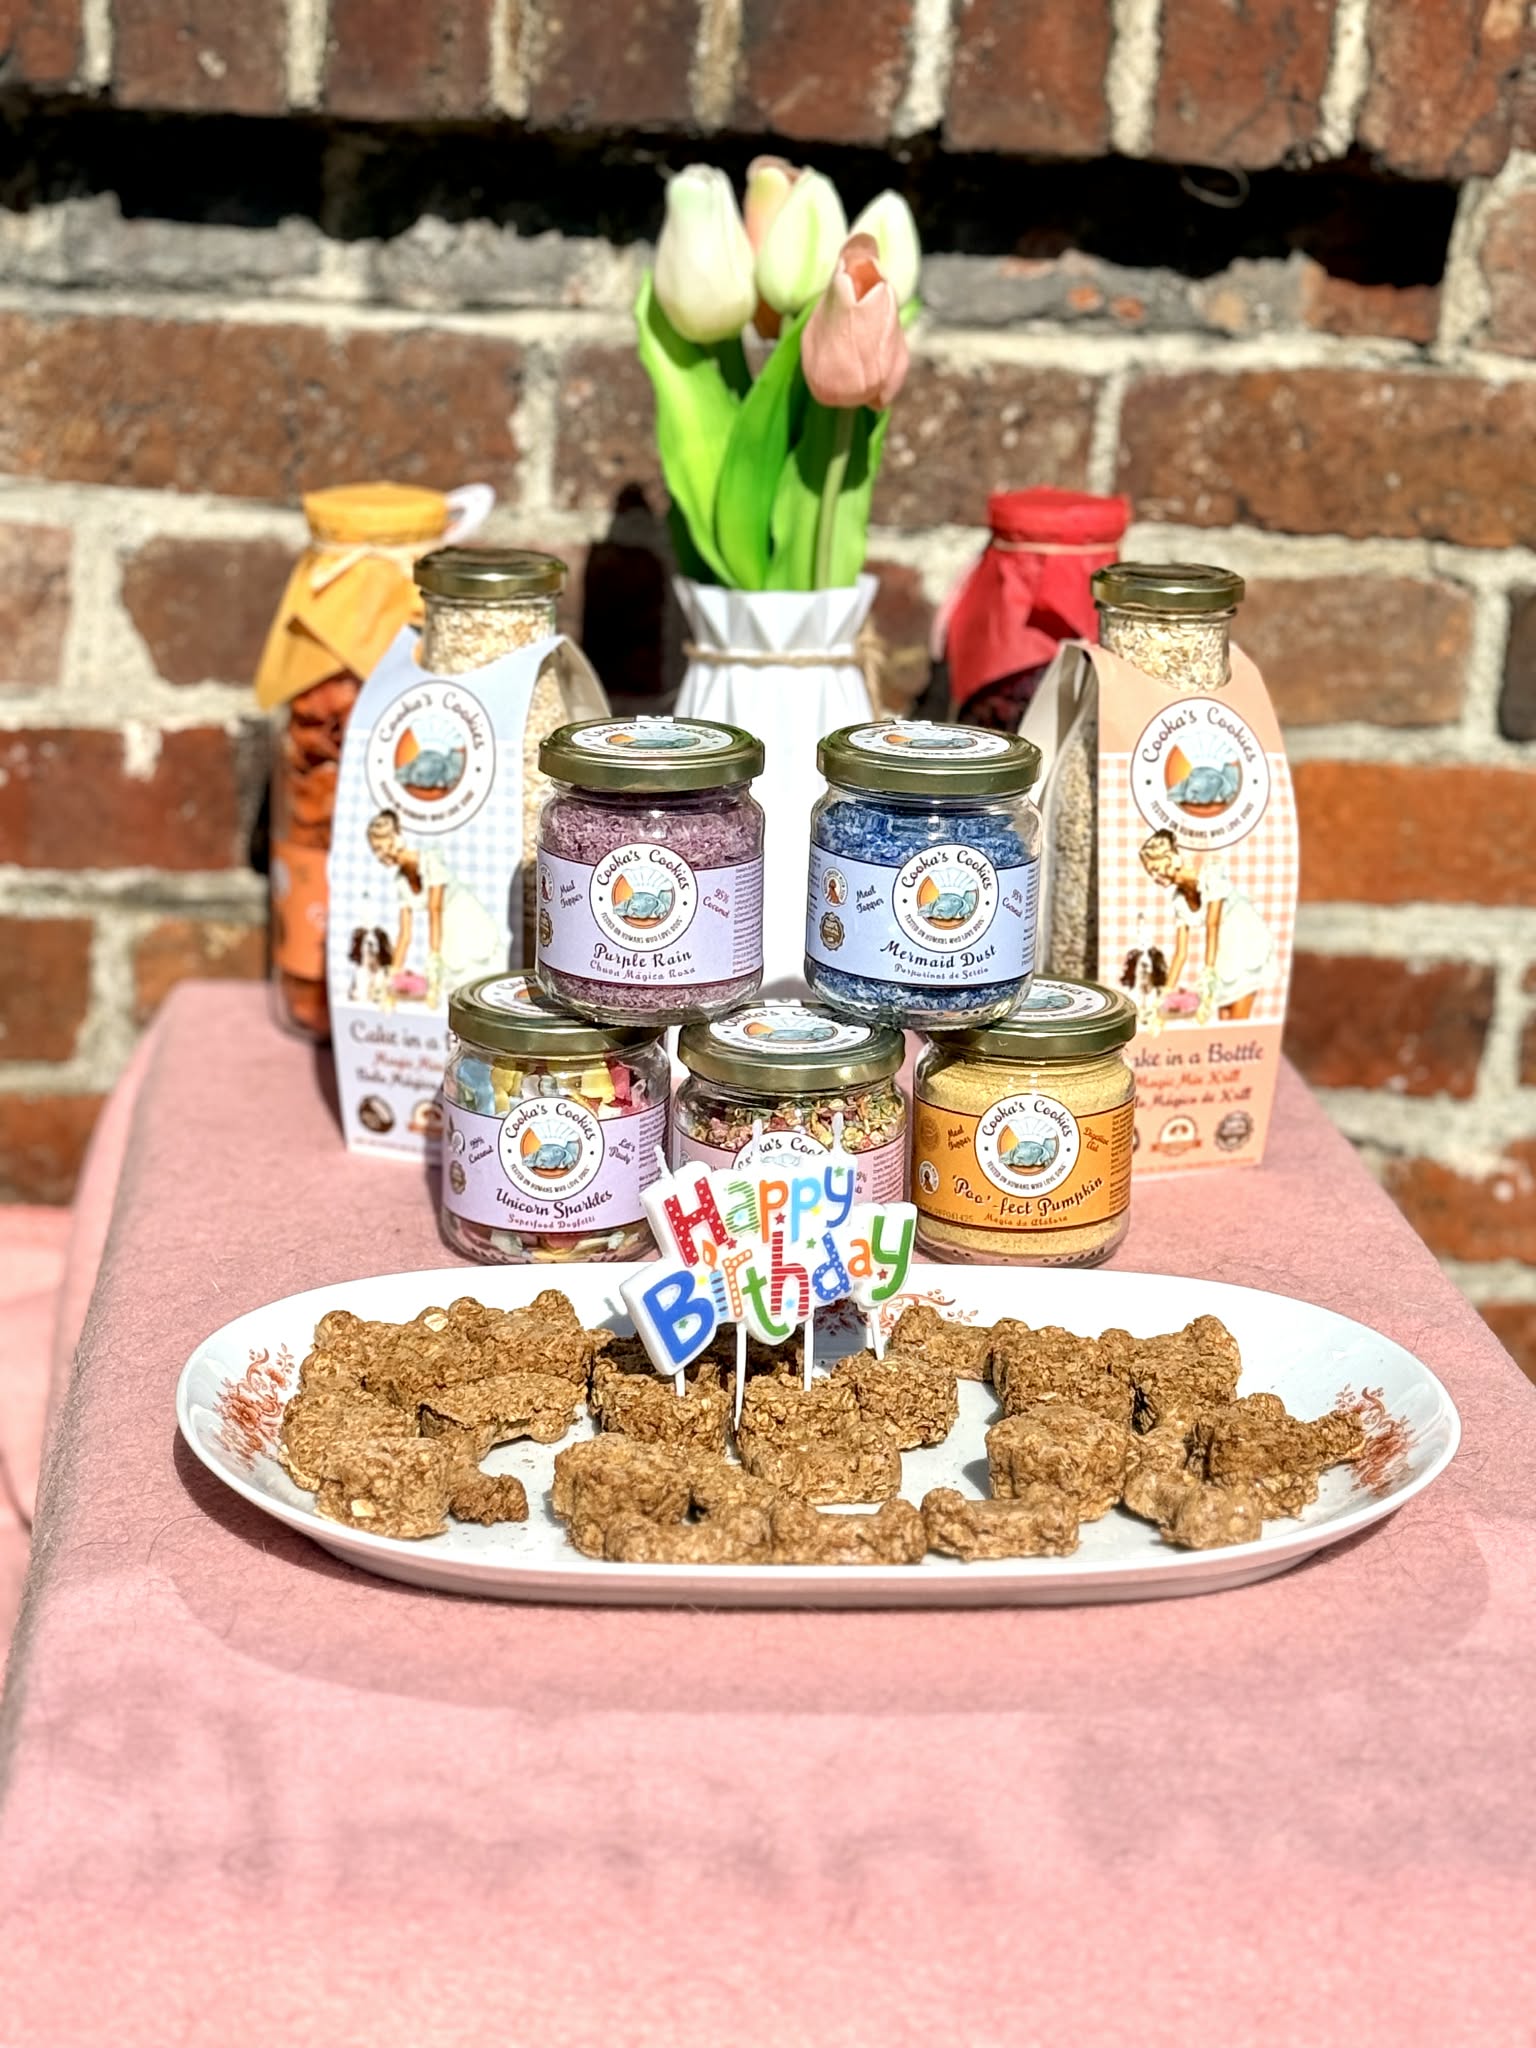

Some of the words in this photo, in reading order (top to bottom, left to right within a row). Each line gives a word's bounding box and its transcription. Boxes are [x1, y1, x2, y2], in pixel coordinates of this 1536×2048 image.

[443, 691, 485, 750] Cookies
[1142, 709, 1198, 763] Cooka's
[1207, 706, 1257, 763] Cookies
[597, 850, 641, 886] Cooka's
[649, 849, 690, 890] Cookies
[902, 851, 949, 888] Cooka's
[957, 850, 992, 890] Cookies
[714, 888, 730, 904] 95%
[856, 885, 876, 903] Meal
[856, 898, 884, 913] Topper
[593, 943, 647, 969] Purple
[653, 951, 692, 967] Rain
[880, 940, 954, 968] Mermaid
[960, 945, 996, 967] Dust
[1166, 1048, 1183, 1066] in
[1189, 1053, 1200, 1065] a
[1208, 1040, 1264, 1063] Bottle
[505, 1104, 548, 1138] Cooka's
[556, 1103, 596, 1140] Cookies
[982, 1101, 1025, 1136] Cooka's
[1034, 1100, 1072, 1137] Cookies
[496, 1188, 549, 1216] Unicorn
[554, 1190, 613, 1219] Sparkles
[1037, 1177, 1103, 1216] Pumpkin
[508, 1214, 554, 1229] Superfood
[663, 1166, 854, 1267] Happy
[642, 1231, 914, 1364] Birthday
